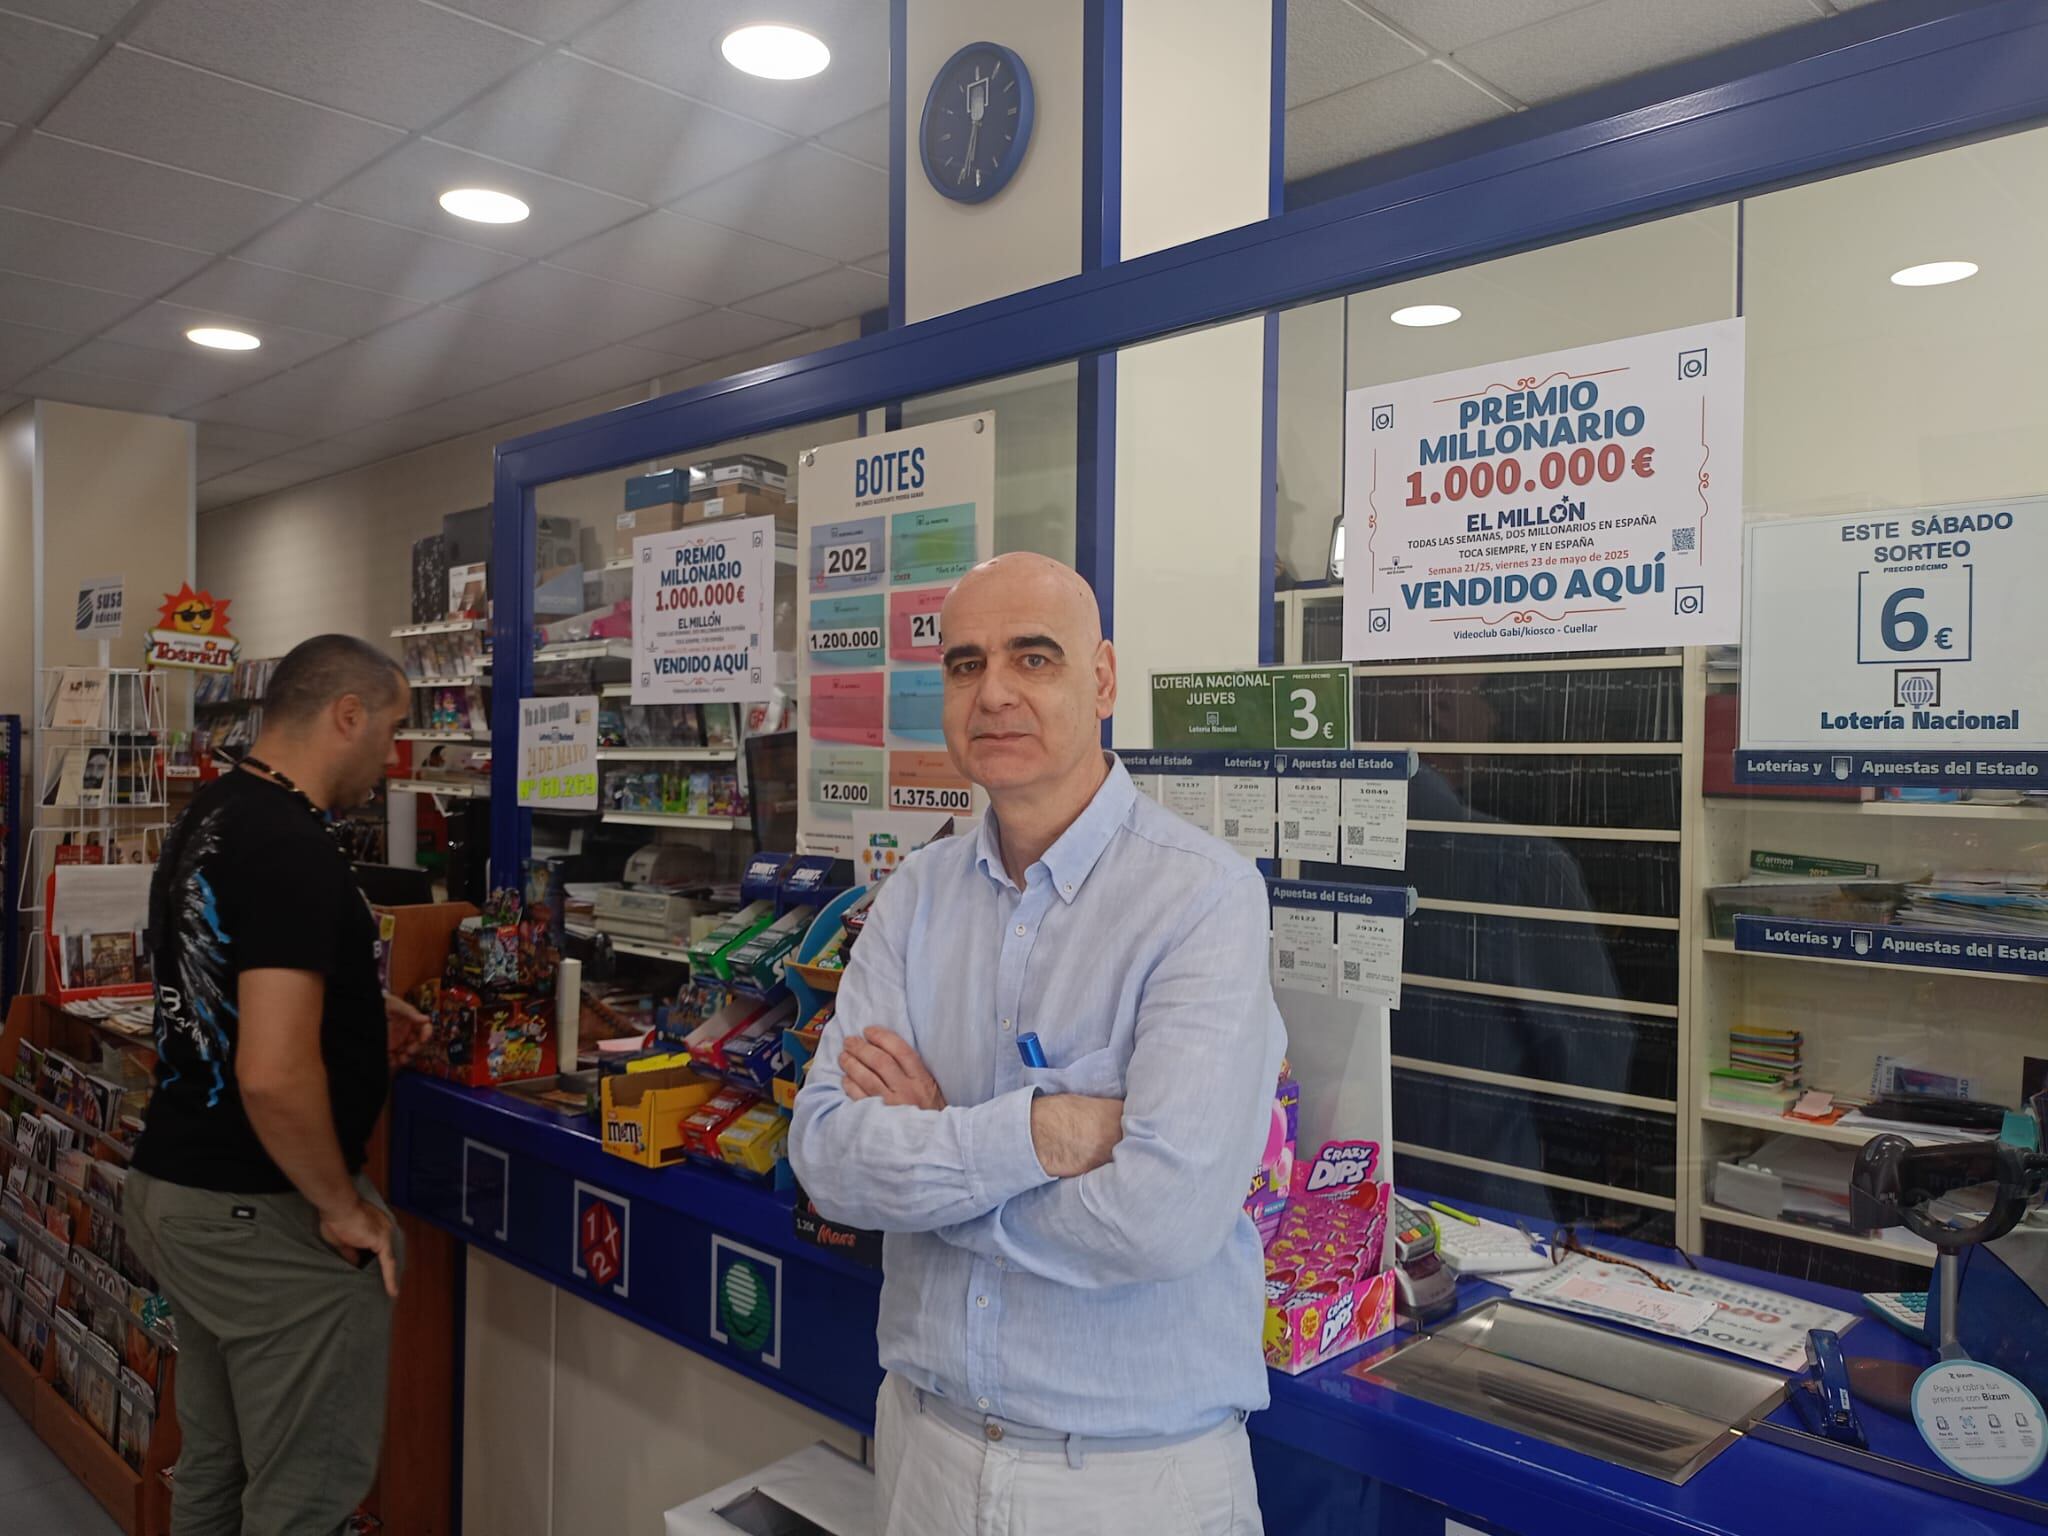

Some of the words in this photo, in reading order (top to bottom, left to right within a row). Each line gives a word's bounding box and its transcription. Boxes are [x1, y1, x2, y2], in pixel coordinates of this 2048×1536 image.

[1459, 381, 1599, 430] PREMIO
[1419, 405, 1646, 466] MILLONARIO
[855, 447, 925, 498] BOTES
[1467, 513, 1492, 533] EL
[1497, 495, 1585, 530] MILLÓN
[1408, 539, 1437, 549] TODAS
[1438, 537, 1455, 547] LAS
[1456, 532, 1503, 546] SEMANAS,
[1506, 528, 1526, 539] DOS
[1528, 521, 1596, 537] MILLONARIOS
[1599, 520, 1612, 530] EN
[1615, 514, 1657, 528] ESPAÑA
[1841, 521, 1900, 542] ESTE
[1911, 512, 2013, 537] SÁBADO
[675, 544, 726, 567] PREMIO
[1459, 549, 1483, 559] TOCA
[1485, 544, 1529, 557] SIEMPRE,
[1531, 543, 1537, 552] Y
[1539, 541, 1553, 551] EN
[1555, 537, 1595, 550] ESPAÑA
[1873, 540, 1971, 563] SORTEO
[828, 547, 867, 574] 202
[1428, 565, 1462, 576] Semana
[1464, 562, 1493, 573] 21/25,
[1496, 560, 1529, 571] viernes
[1531, 556, 1542, 567] 23
[1545, 555, 1557, 565] de
[1559, 554, 1587, 566] mayo
[1589, 552, 1602, 562] de
[1604, 550, 1629, 561] 2025
[1883, 565, 1914, 574] PRECIO
[1914, 562, 1948, 572] DÉCIMO
[661, 560, 742, 588] MILLONARIO
[1400, 571, 1557, 610] VENDIDO
[1563, 551, 1666, 603] AQUÍ
[678, 618, 688, 629] EL
[689, 610, 721, 628] MILLÓN
[811, 630, 879, 650] 1.200.000
[1453, 626, 1498, 640] Videoclub
[1499, 625, 1555, 638] Gabi/kiosco
[1563, 623, 1598, 635] Cuellar
[654, 655, 710, 675] VENDIDO
[713, 646, 748, 675] AQUÍ
[1153, 673, 1204, 690] LOTERÍA
[1206, 674, 1271, 688] NACIONAL
[1186, 692, 1236, 706] JUEVES
[1820, 710, 1905, 730] Lotería
[1911, 709, 2020, 730] Nacional
[1149, 756, 1162, 766] del
[1164, 756, 1193, 766] Estado
[1224, 757, 1262, 768] Loterías
[1264, 759, 1270, 770] y
[1292, 758, 1337, 770] Apuestas
[1340, 758, 1355, 769] del
[1358, 758, 1394, 769] Estado
[1747, 759, 1809, 773] Loterías
[1812, 762, 1823, 776] y
[1861, 760, 1940, 778] Apuestas
[1944, 761, 1971, 775] del
[1976, 762, 2039, 776] Estado
[822, 784, 868, 801] 12.000
[893, 788, 970, 808] 1.375.000
[1273, 887, 1318, 900] Apuestas
[1320, 891, 1335, 901] del
[1337, 893, 1373, 904] Estado
[1765, 928, 1828, 945] Loterías
[1832, 934, 1842, 949] y
[1881, 937, 1961, 957] Apuestas
[1966, 943, 1993, 958] del
[1322, 1145, 1374, 1161] CRAZY
[1306, 1160, 1371, 1191] DIPS
[817, 1223, 856, 1247] Mars
[1326, 1290, 1353, 1321] CRAZY
[1689, 1284, 1791, 1315] PREMIO
[1320, 1300, 1354, 1355] DIPS
[1933, 1384, 1954, 1394] Paga
[1981, 1392, 2010, 1401] Bizum
